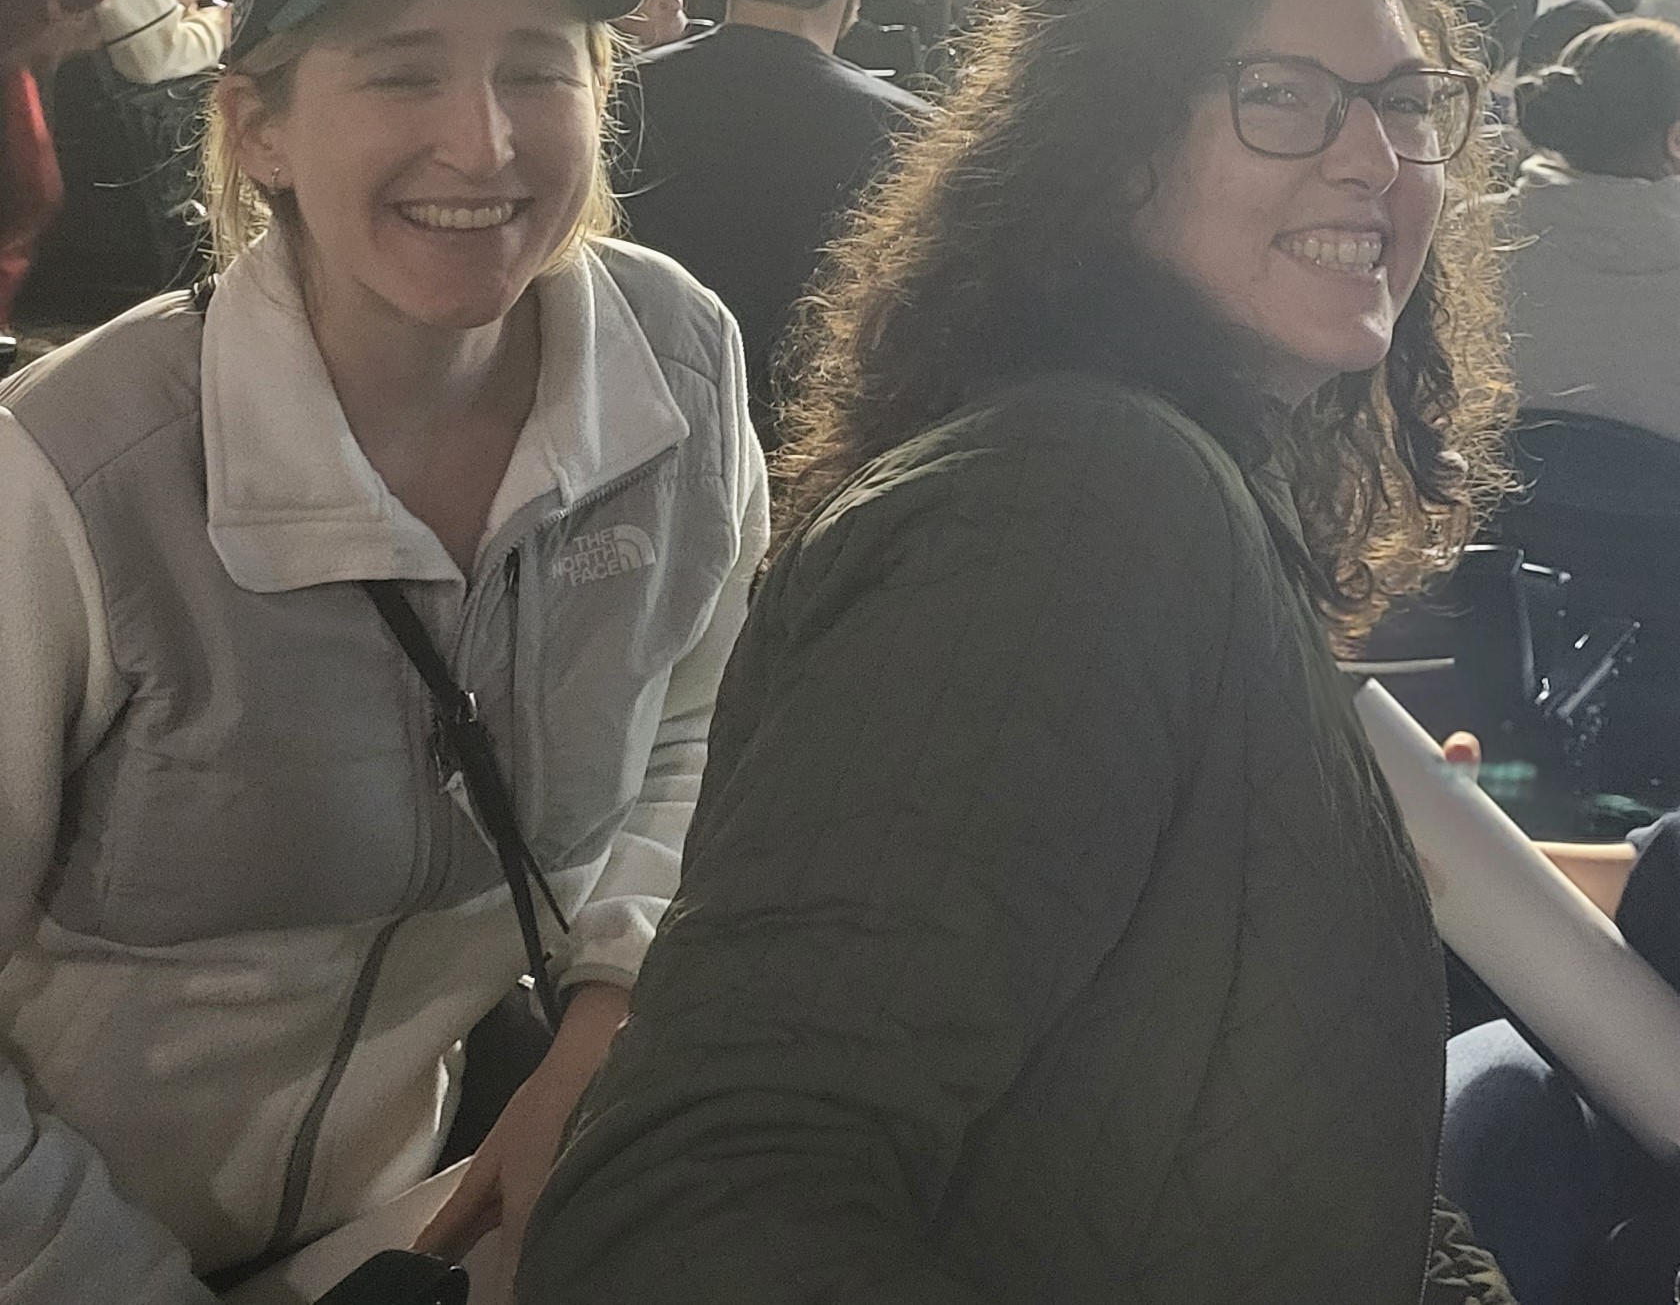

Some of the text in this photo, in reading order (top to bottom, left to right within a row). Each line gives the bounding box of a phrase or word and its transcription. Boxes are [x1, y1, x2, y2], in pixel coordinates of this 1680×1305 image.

[573, 529, 615, 552] THE
[552, 547, 618, 579] NORTH
[569, 558, 621, 587] FACE
